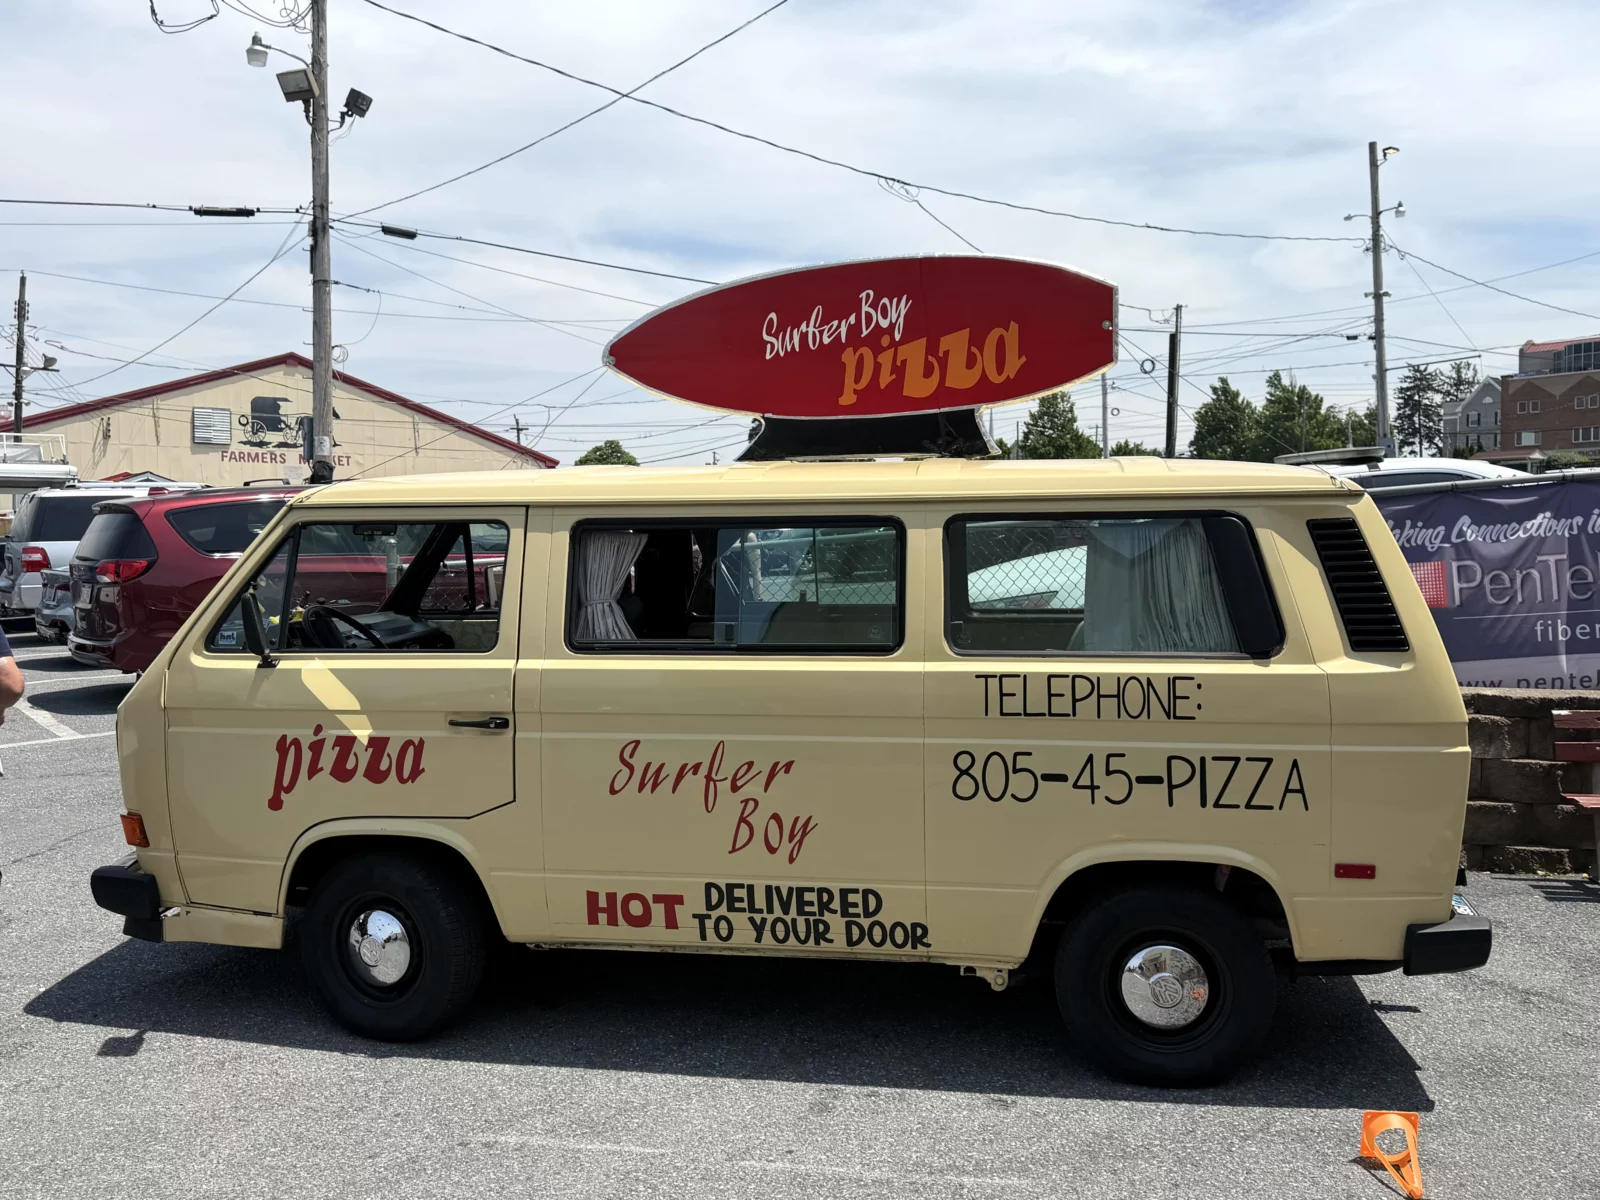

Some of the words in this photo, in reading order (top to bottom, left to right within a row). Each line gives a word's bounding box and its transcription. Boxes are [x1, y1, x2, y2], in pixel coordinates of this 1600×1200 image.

[761, 305, 856, 360] Surfer
[858, 289, 913, 341] Boy
[838, 320, 1027, 406] pizza
[220, 450, 287, 464] FARMERS
[1450, 511, 1585, 544] Connections
[974, 673, 1203, 721] TELEPHONE:
[267, 723, 426, 812] pizza
[608, 739, 796, 814] Surfer
[951, 749, 1310, 812] 805-45-PIZZA
[727, 797, 819, 865] Boy
[585, 889, 685, 930] HOT
[703, 881, 884, 919] DELIVERED
[691, 912, 735, 943] TO
[747, 916, 835, 947] YOUR
[844, 919, 933, 950] DOOR
